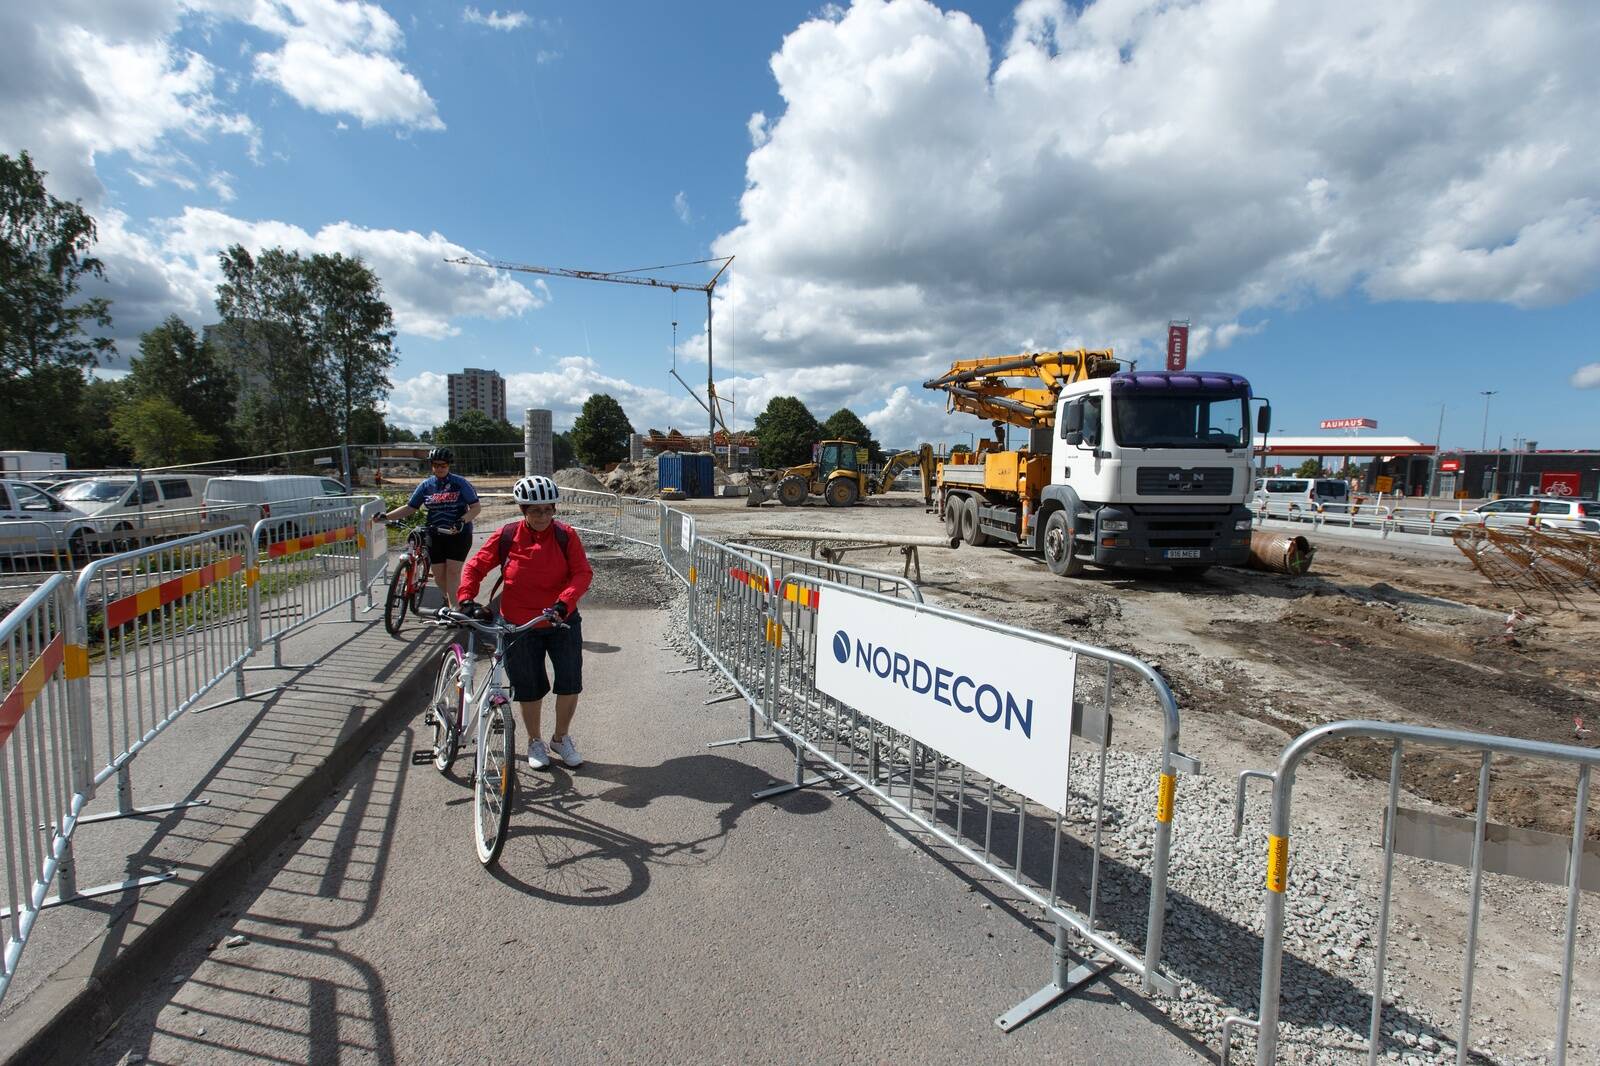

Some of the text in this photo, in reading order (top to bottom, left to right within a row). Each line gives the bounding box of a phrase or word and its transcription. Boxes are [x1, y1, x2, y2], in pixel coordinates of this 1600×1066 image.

[1320, 419, 1363, 428] BAUHAUS
[1168, 473, 1204, 481] MN
[855, 637, 1034, 740] NORDECON
[1273, 839, 1283, 876] Ramudden
